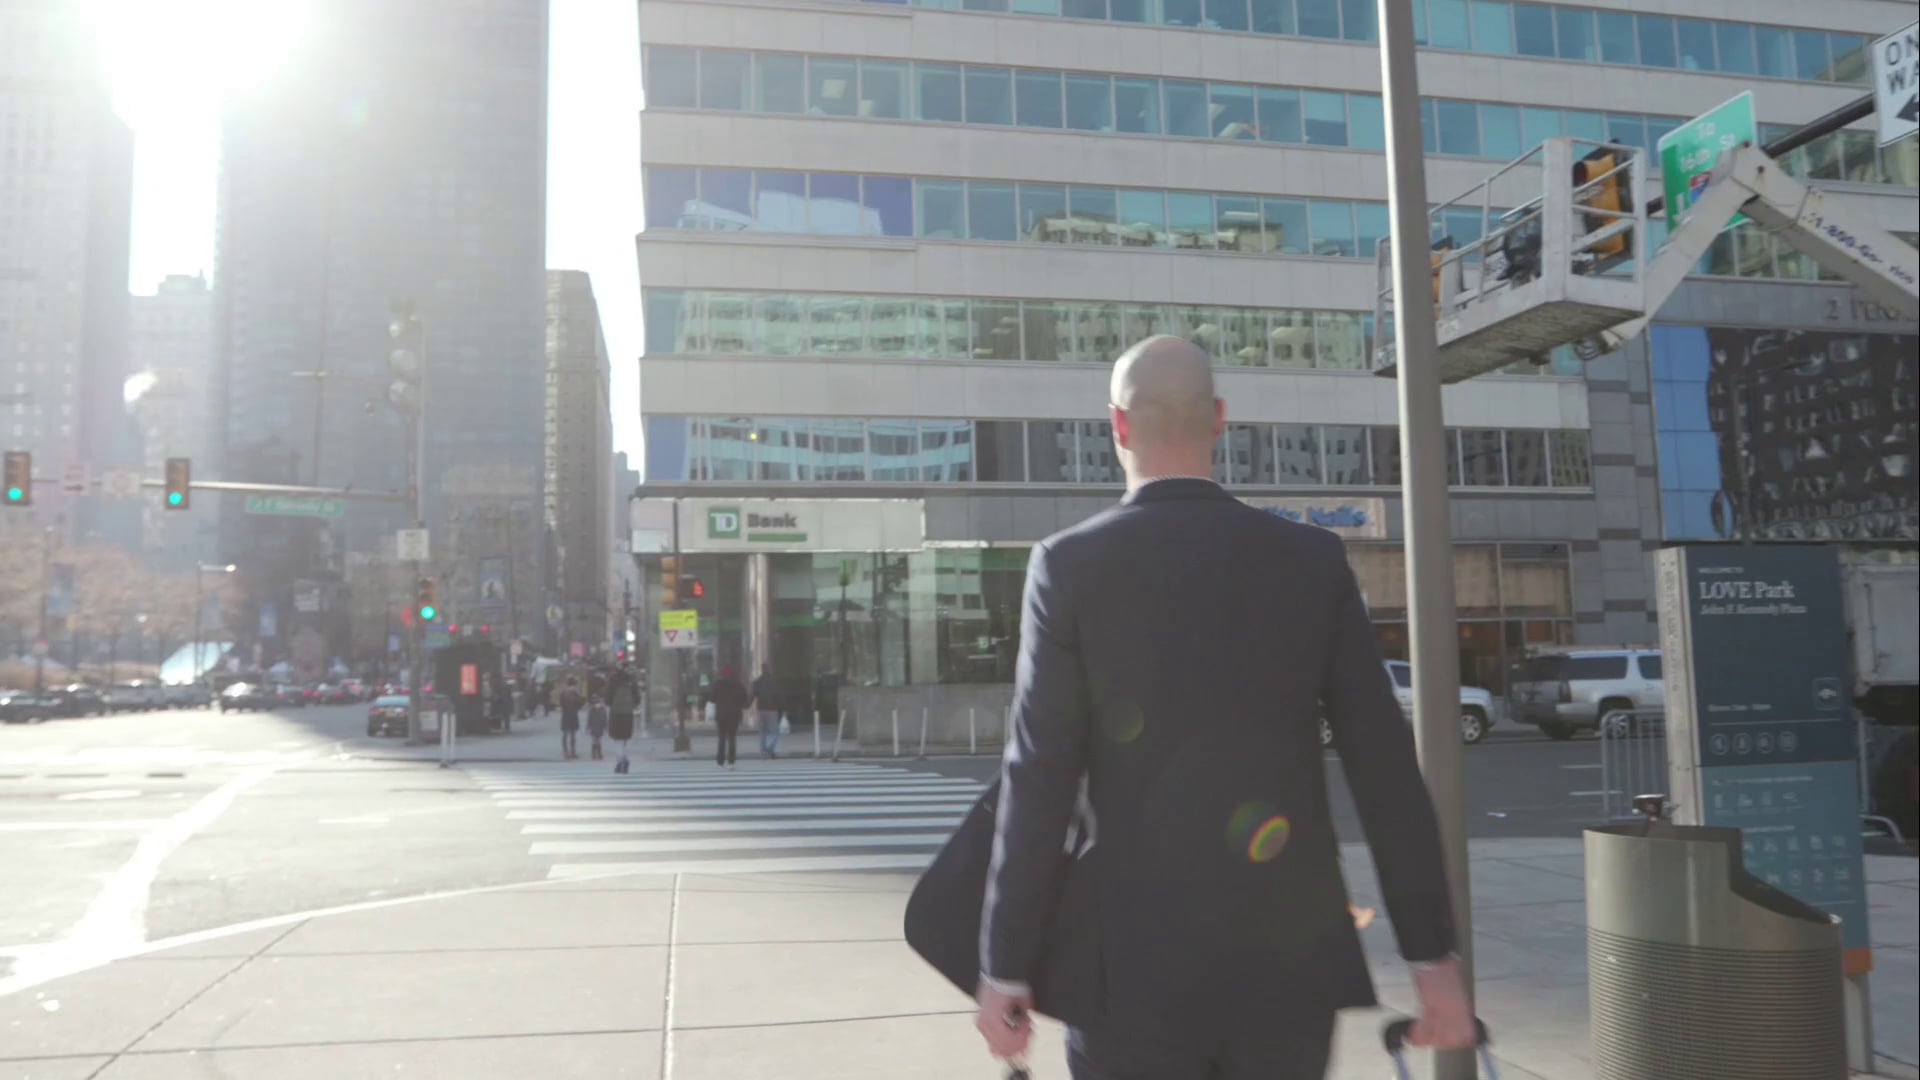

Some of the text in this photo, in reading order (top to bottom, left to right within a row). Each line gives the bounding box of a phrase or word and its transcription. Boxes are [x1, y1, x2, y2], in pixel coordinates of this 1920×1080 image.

[1886, 35, 1919, 66] ON
[710, 512, 797, 532] TD Bank
[1699, 580, 1795, 599] LOVE Park
[1737, 604, 1778, 616] Kennedy
